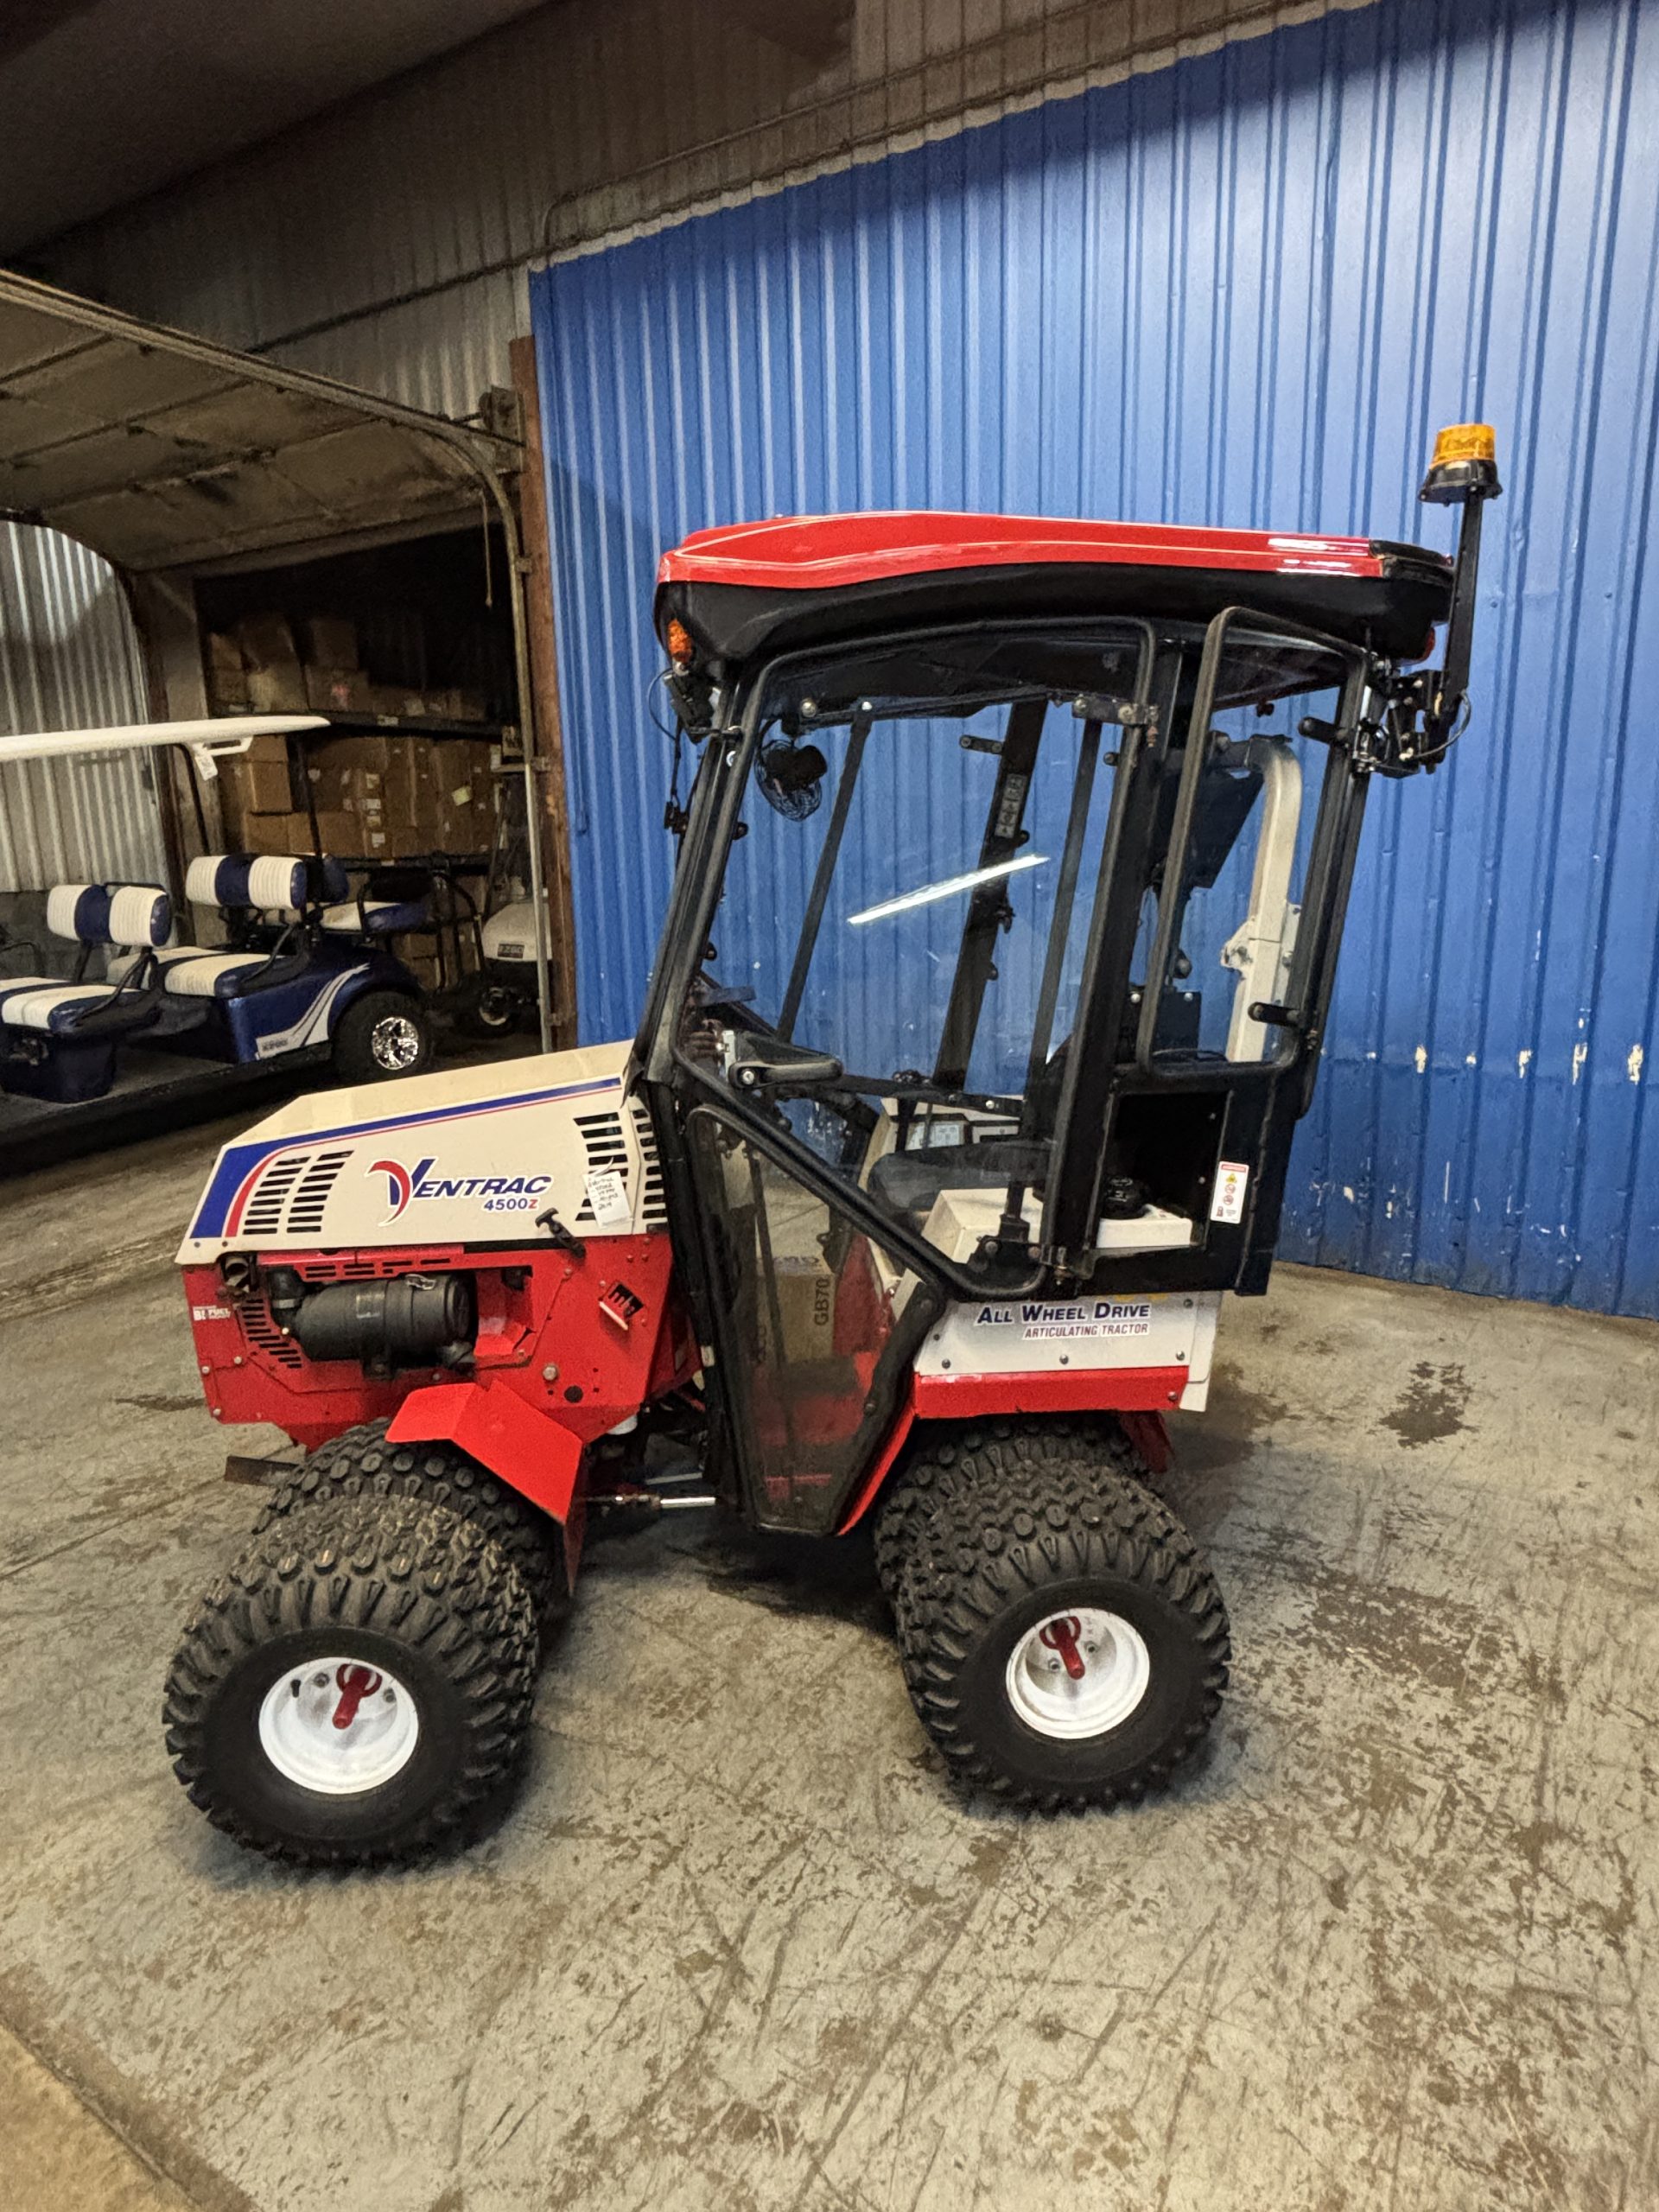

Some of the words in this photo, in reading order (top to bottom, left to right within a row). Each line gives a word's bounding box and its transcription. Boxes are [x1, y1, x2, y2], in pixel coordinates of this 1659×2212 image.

[368, 1159, 552, 1223] VENTRAC
[484, 1198, 538, 1211] 4500Z
[814, 1279, 830, 1326] GB70
[977, 1306, 1013, 1324] ALL
[1021, 1304, 1086, 1322] WHEEL
[1094, 1302, 1150, 1319] DRIVE
[1025, 1325, 1098, 1338] ARTICULATING
[1102, 1323, 1148, 1335] TRACTOR
